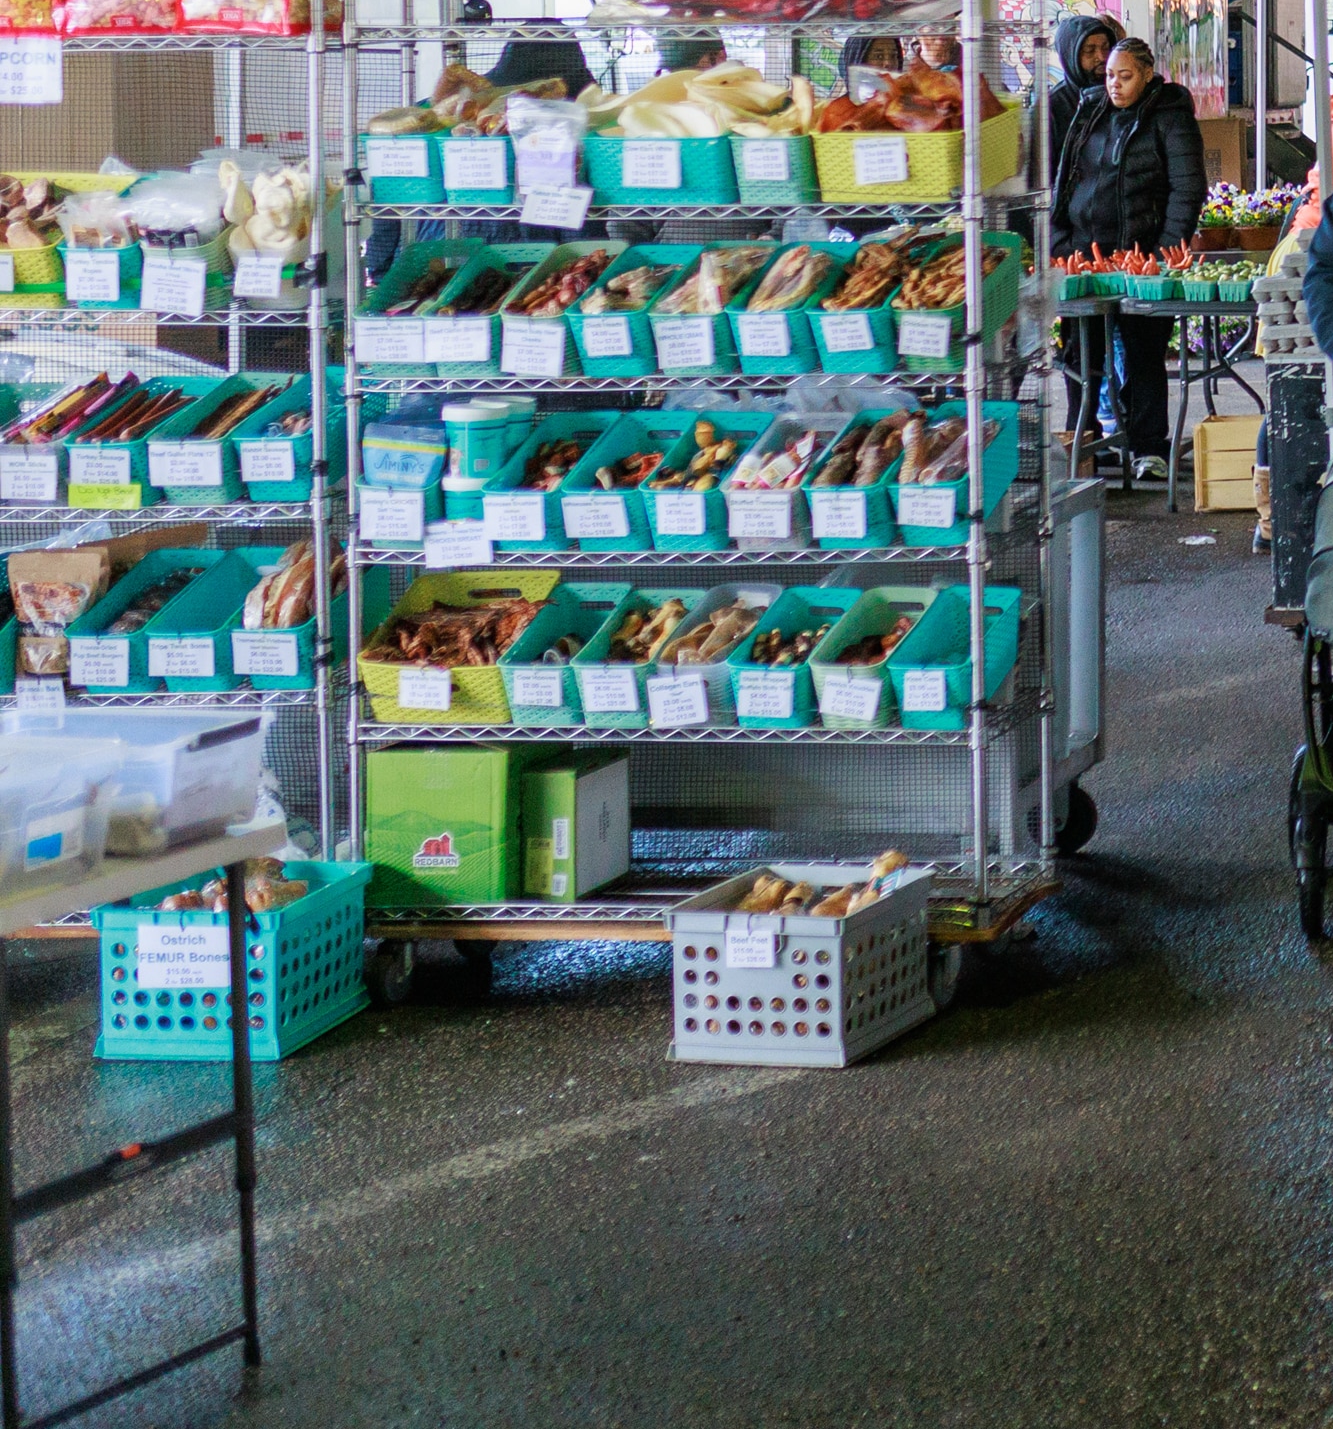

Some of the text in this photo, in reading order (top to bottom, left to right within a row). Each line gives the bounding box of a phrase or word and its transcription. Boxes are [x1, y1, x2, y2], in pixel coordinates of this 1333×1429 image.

[414, 857, 458, 866] REDBARN
[161, 934, 206, 945] Ostrich
[140, 952, 229, 963] FEMUR Bones
